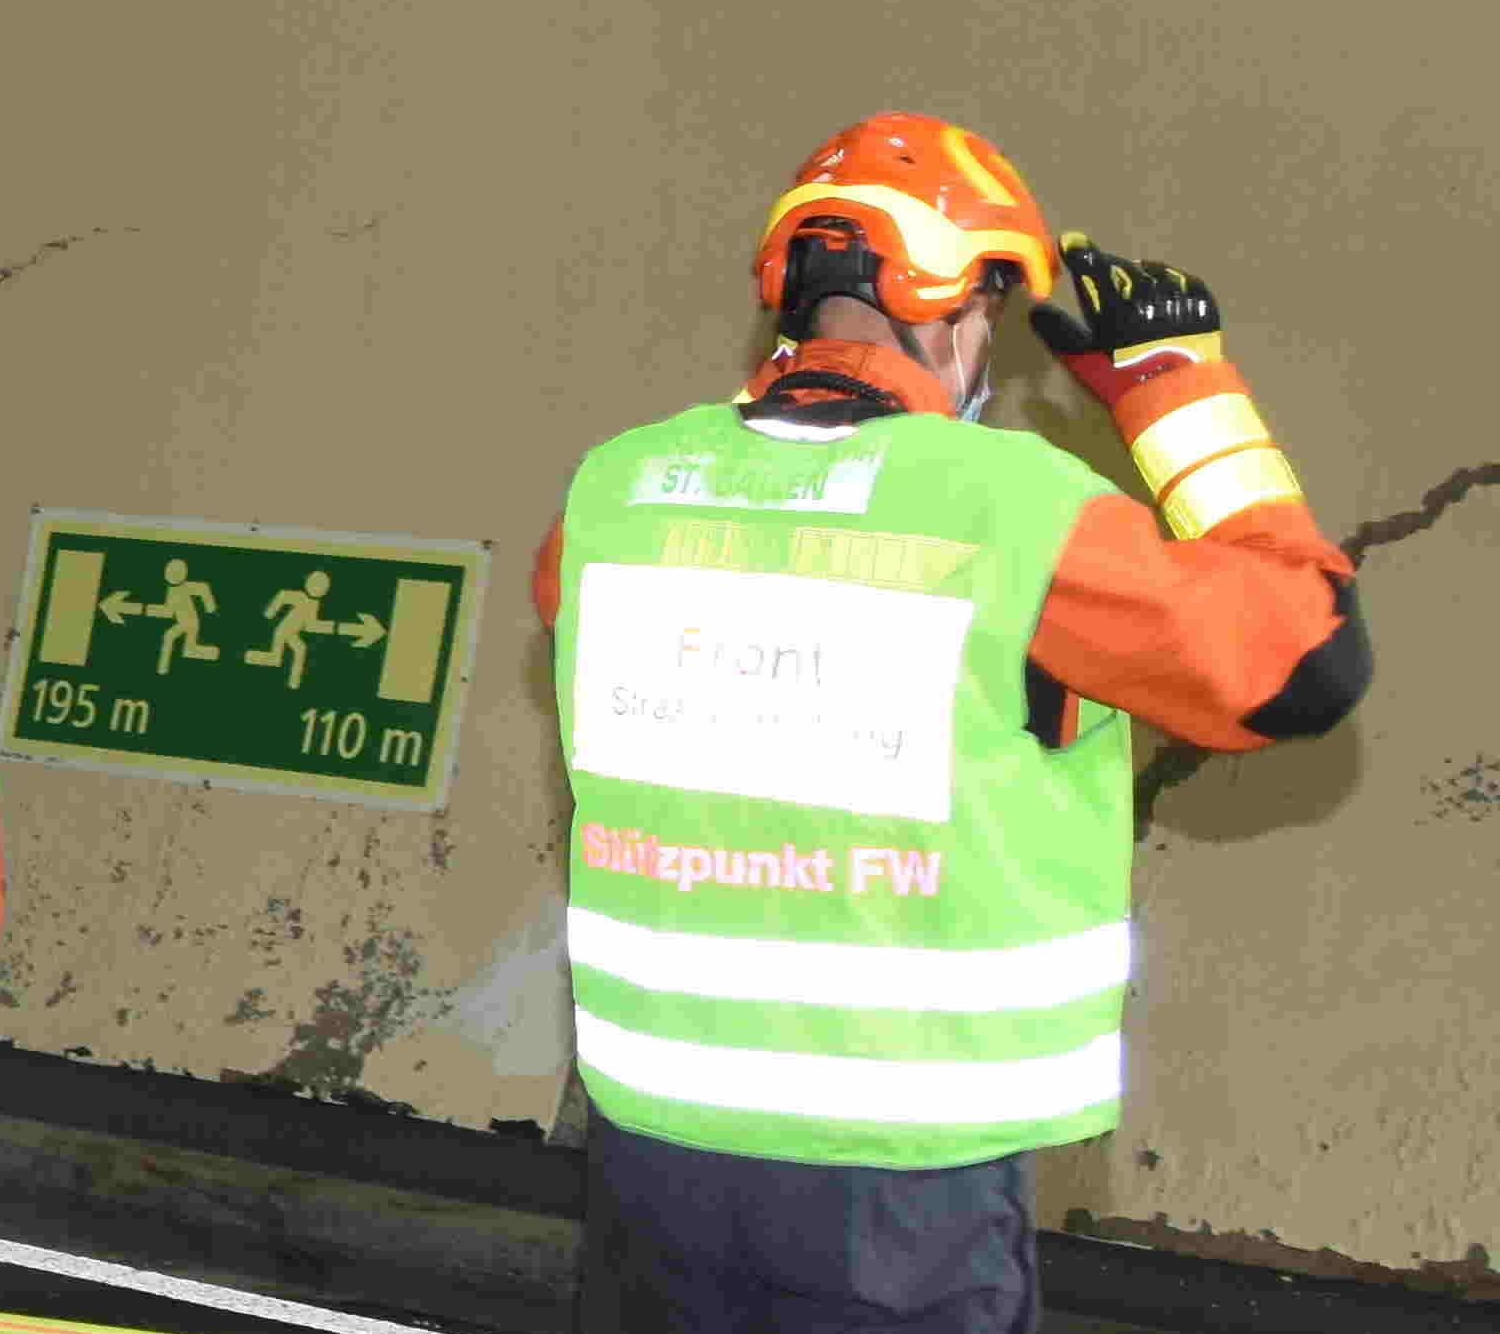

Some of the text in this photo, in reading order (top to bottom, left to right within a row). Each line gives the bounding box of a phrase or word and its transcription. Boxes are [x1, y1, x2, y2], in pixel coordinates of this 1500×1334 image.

[677, 627, 824, 688] Front
[31, 679, 152, 735] 195 m
[300, 708, 423, 767] 110 m
[849, 847, 941, 896] FW
